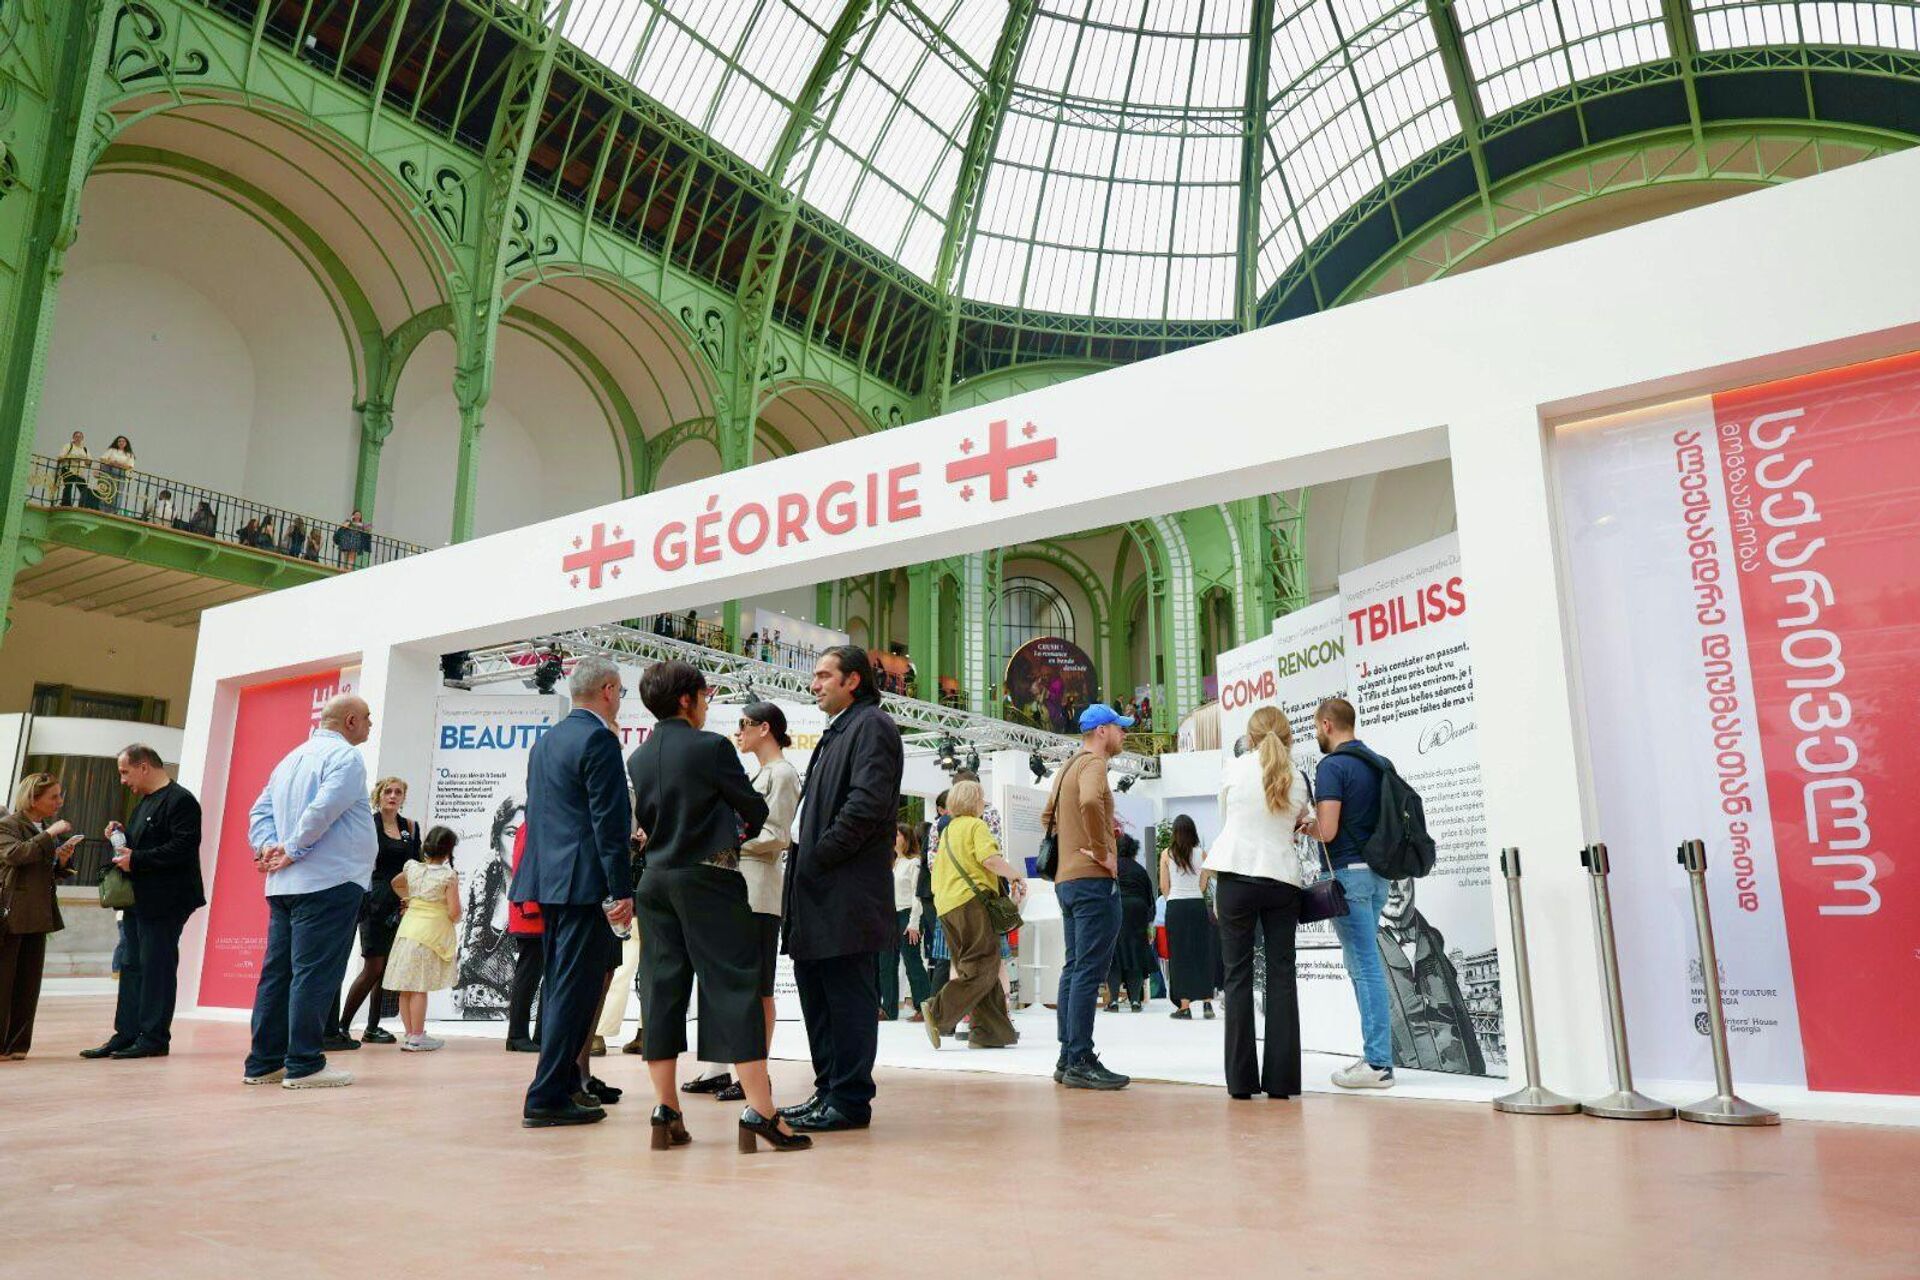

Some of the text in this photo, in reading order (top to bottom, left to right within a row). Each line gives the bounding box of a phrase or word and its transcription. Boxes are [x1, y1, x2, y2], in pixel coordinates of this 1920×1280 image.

[652, 462, 922, 572] GÉORGIE
[1348, 577, 1466, 646] TBILISS
[1278, 636, 1345, 678] RENCON
[1389, 655, 1424, 671] constater
[1426, 661, 1443, 674] tout
[1673, 429, 1760, 913] ალექსანდრე დიუმასთან ერთად
[1748, 407, 1882, 916] საქართველო
[1222, 670, 1278, 711] COMB
[1742, 989, 1777, 997] CULTURE
[1752, 1018, 1778, 1026] House
